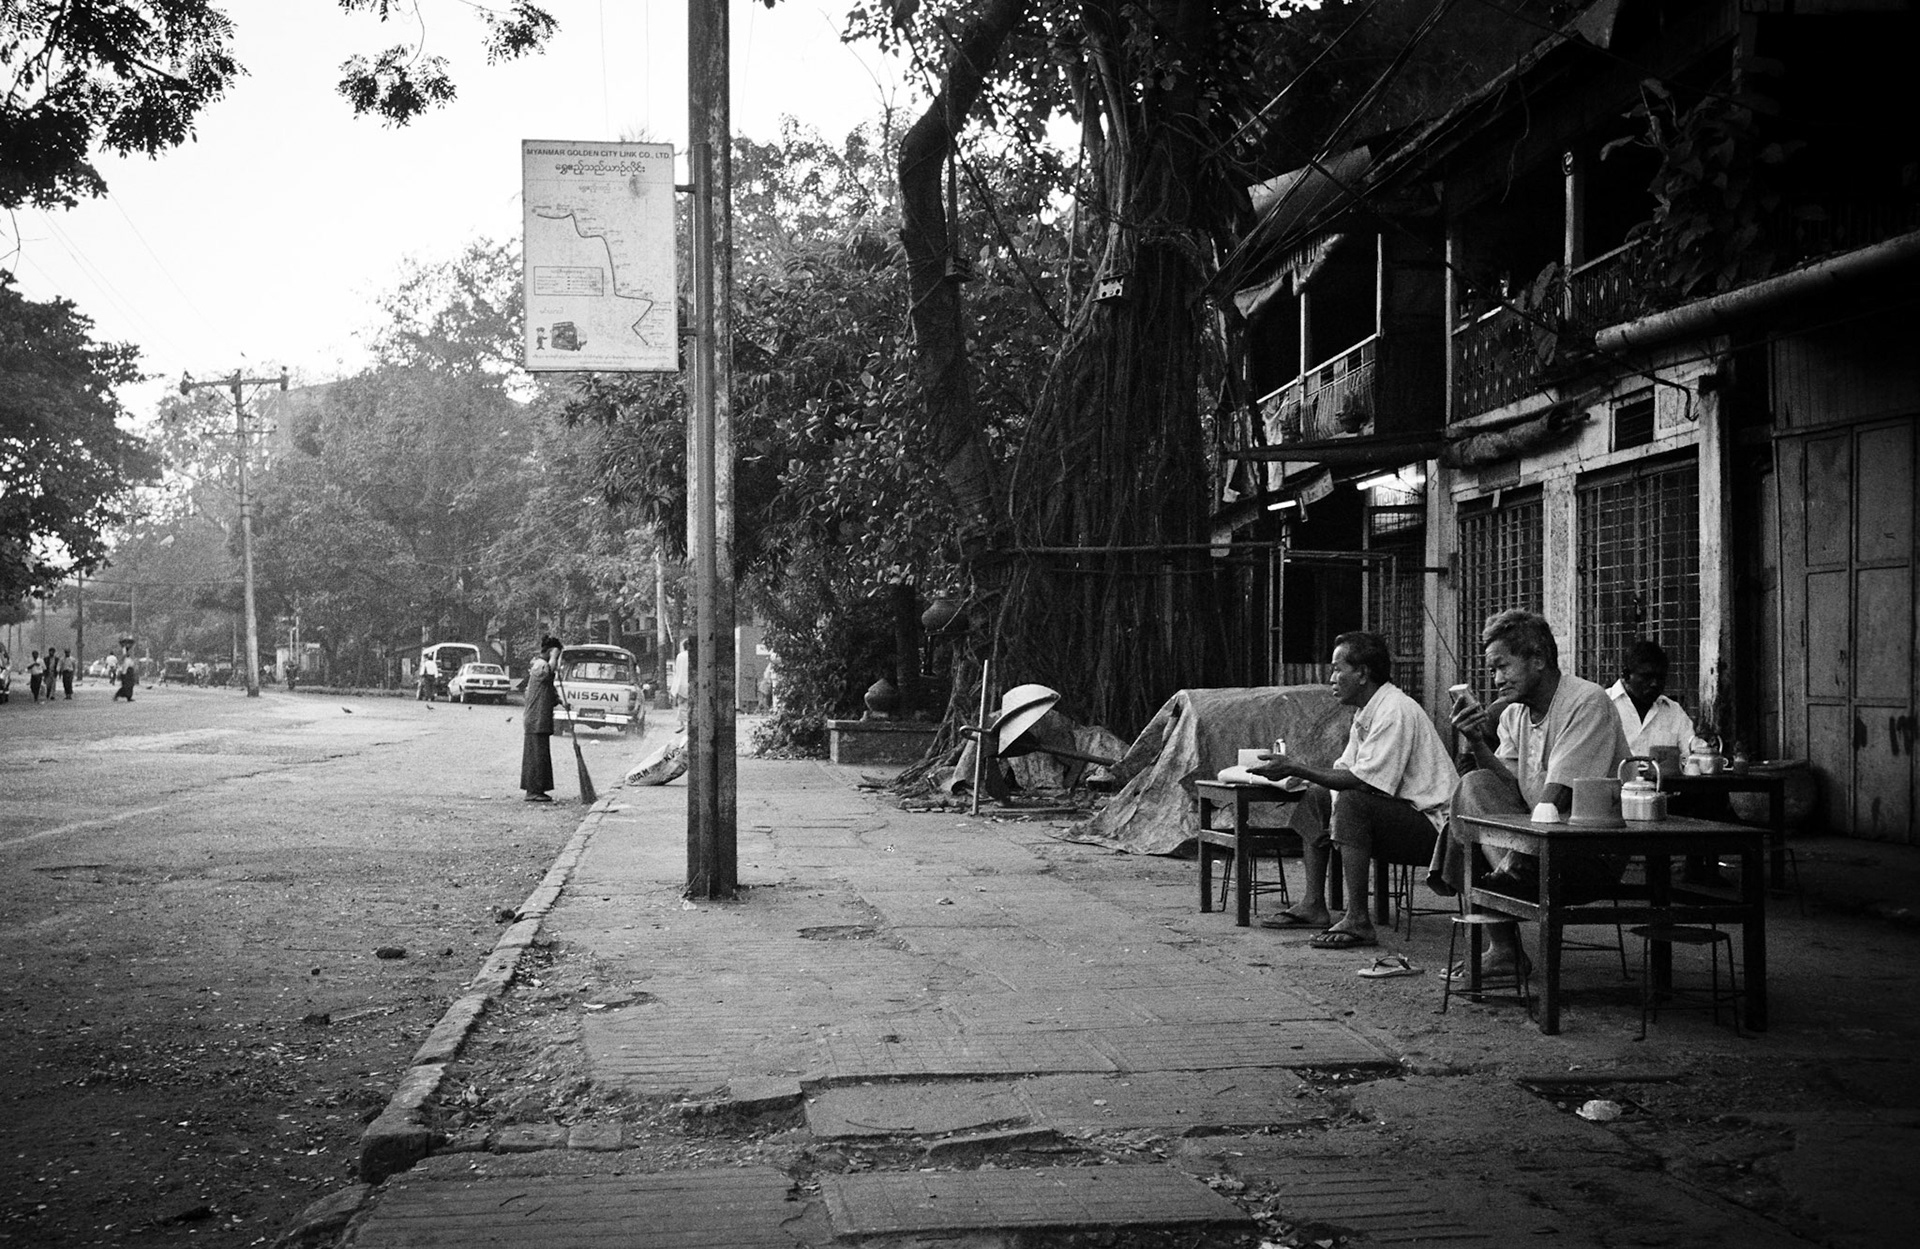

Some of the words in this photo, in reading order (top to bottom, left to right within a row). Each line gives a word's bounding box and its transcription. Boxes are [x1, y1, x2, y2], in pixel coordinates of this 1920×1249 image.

[526, 148, 566, 156] MYANMAR
[567, 149, 599, 157] GOLDEN
[600, 150, 618, 158] CITY
[567, 690, 619, 702] NISSAN
